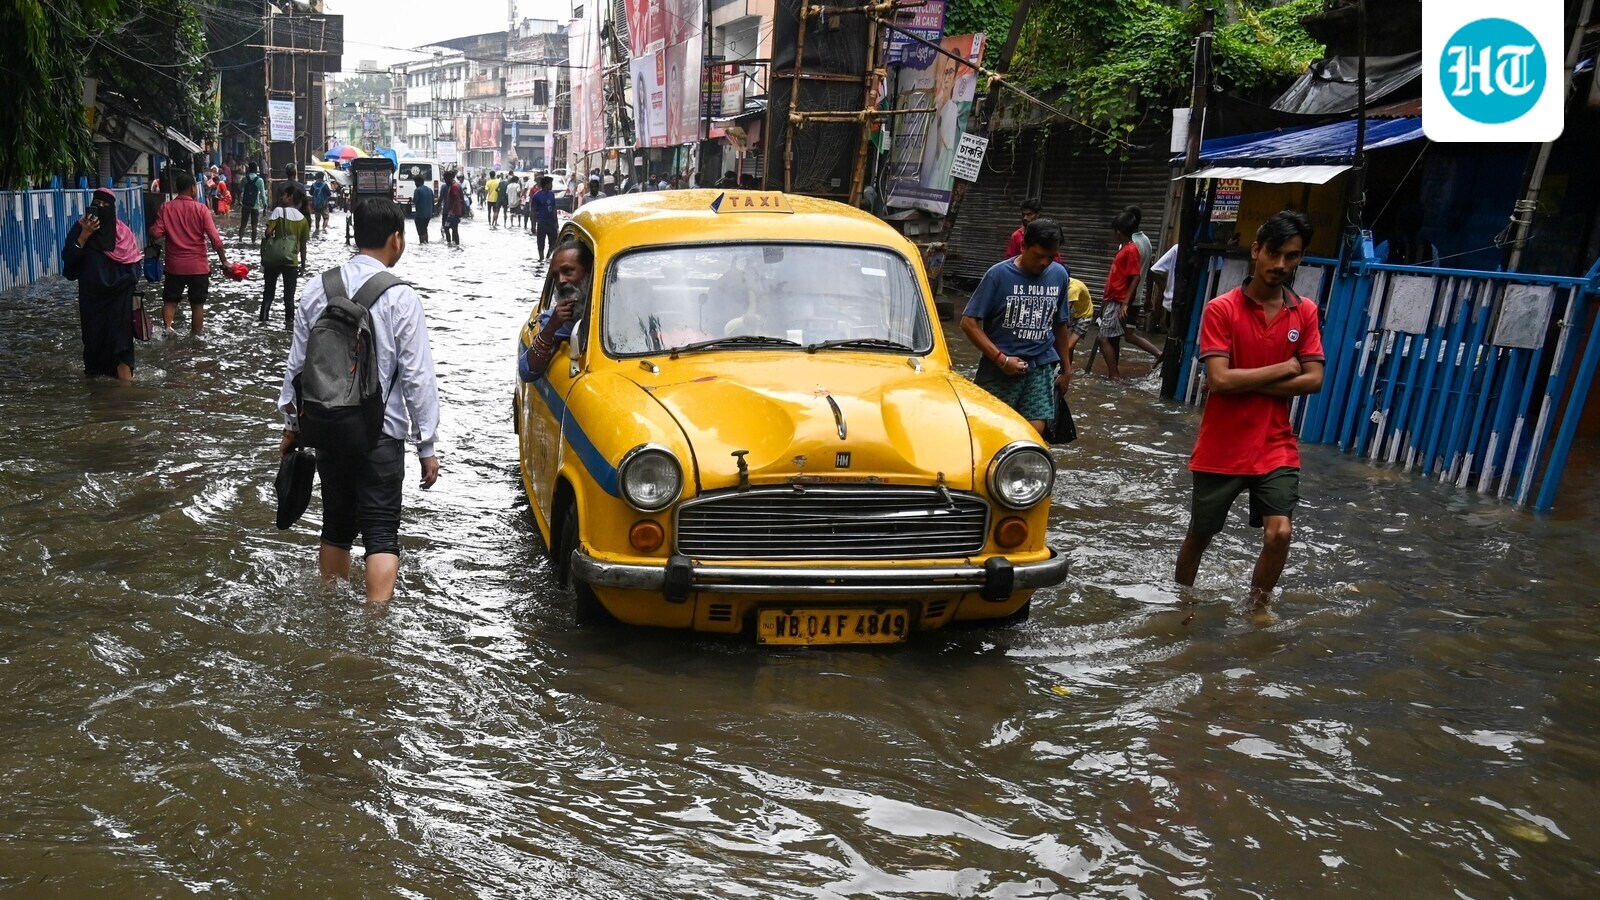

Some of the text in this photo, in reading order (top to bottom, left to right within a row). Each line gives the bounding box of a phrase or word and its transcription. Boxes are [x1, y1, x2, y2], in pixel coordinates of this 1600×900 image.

[921, 16, 939, 27] CARE
[960, 144, 983, 159] চাকরি
[729, 196, 780, 207] TAXI
[1013, 285, 1025, 295] U.S.
[1028, 285, 1044, 296] POLO
[1017, 329, 1046, 340] COMPANY
[836, 454, 849, 466] HM
[776, 615, 800, 637] WB
[854, 614, 905, 637] 4849
